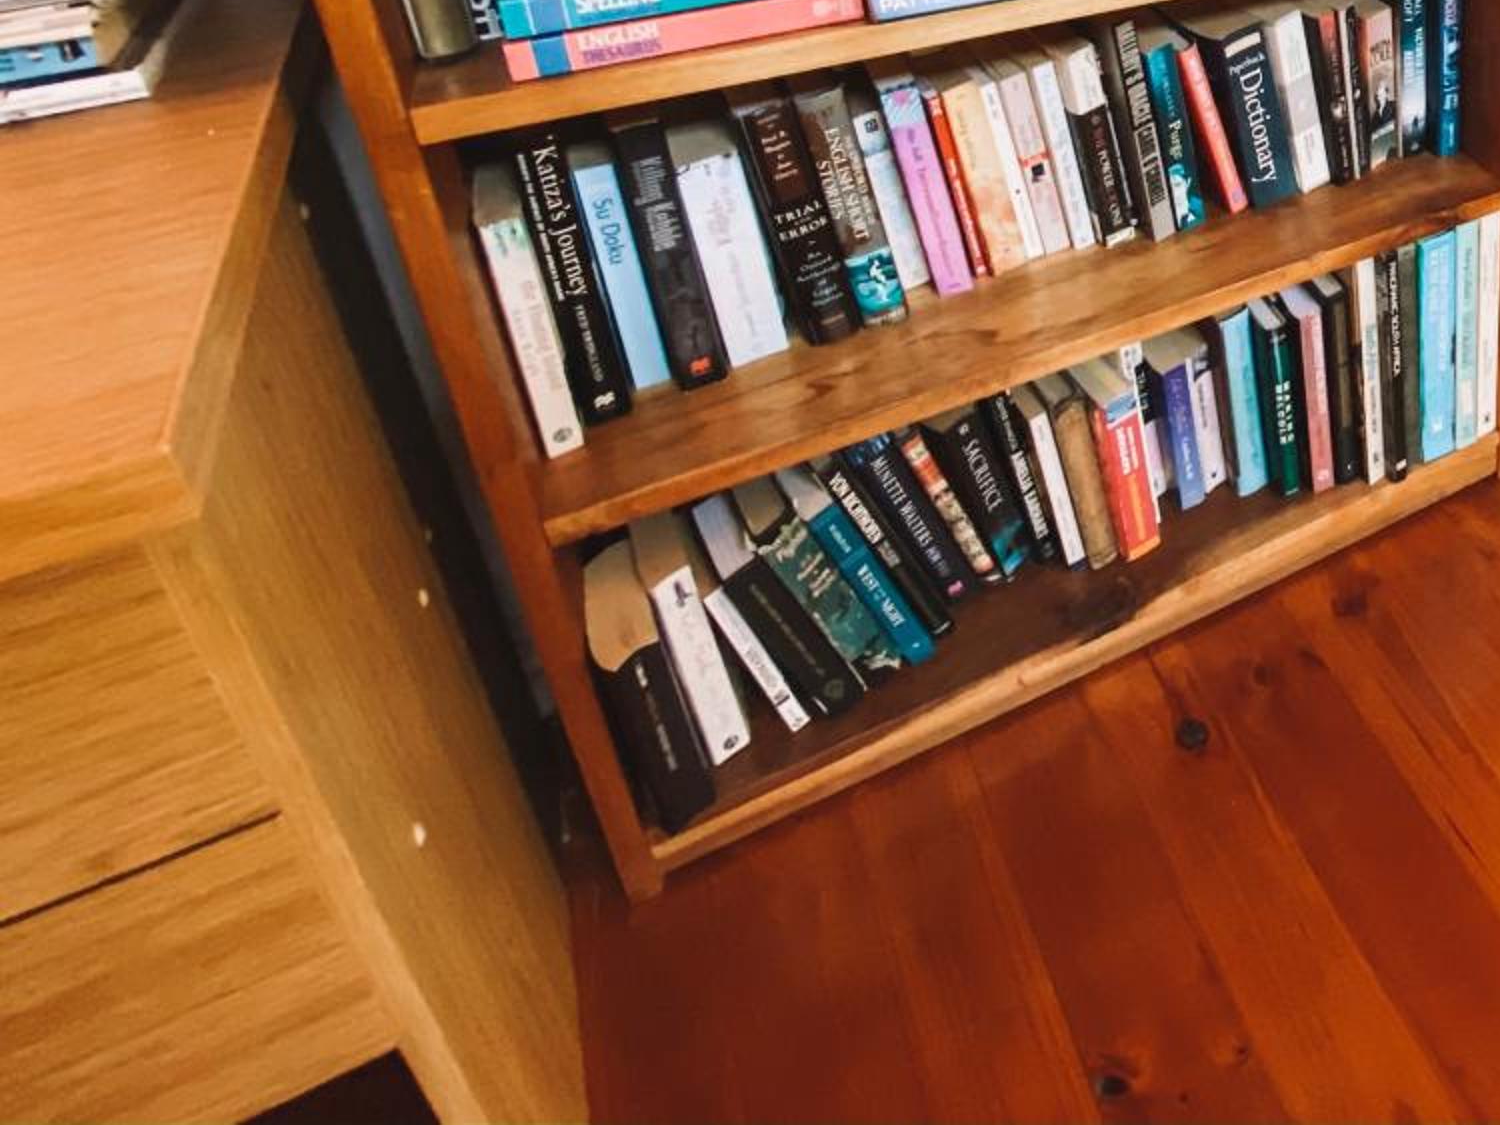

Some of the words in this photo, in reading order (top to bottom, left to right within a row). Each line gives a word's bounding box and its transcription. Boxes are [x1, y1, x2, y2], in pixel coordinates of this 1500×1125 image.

[1239, 69, 1277, 184] Dictionary
[533, 141, 568, 223] Katiza's
[591, 197, 614, 221] Su
[774, 200, 821, 225] TRIAL
[815, 159, 844, 220] STORIES
[826, 127, 859, 191] ENGLISH
[844, 189, 870, 241] SHORT
[550, 223, 589, 300] Journey
[599, 223, 624, 266] Doku
[778, 217, 829, 242] ERROR
[869, 455, 906, 506] MINETTE
[897, 501, 934, 548] WALTERS
[961, 438, 1004, 513] SACRIFICE
[857, 563, 878, 593] WEST
[880, 597, 906, 628] NIGHT
